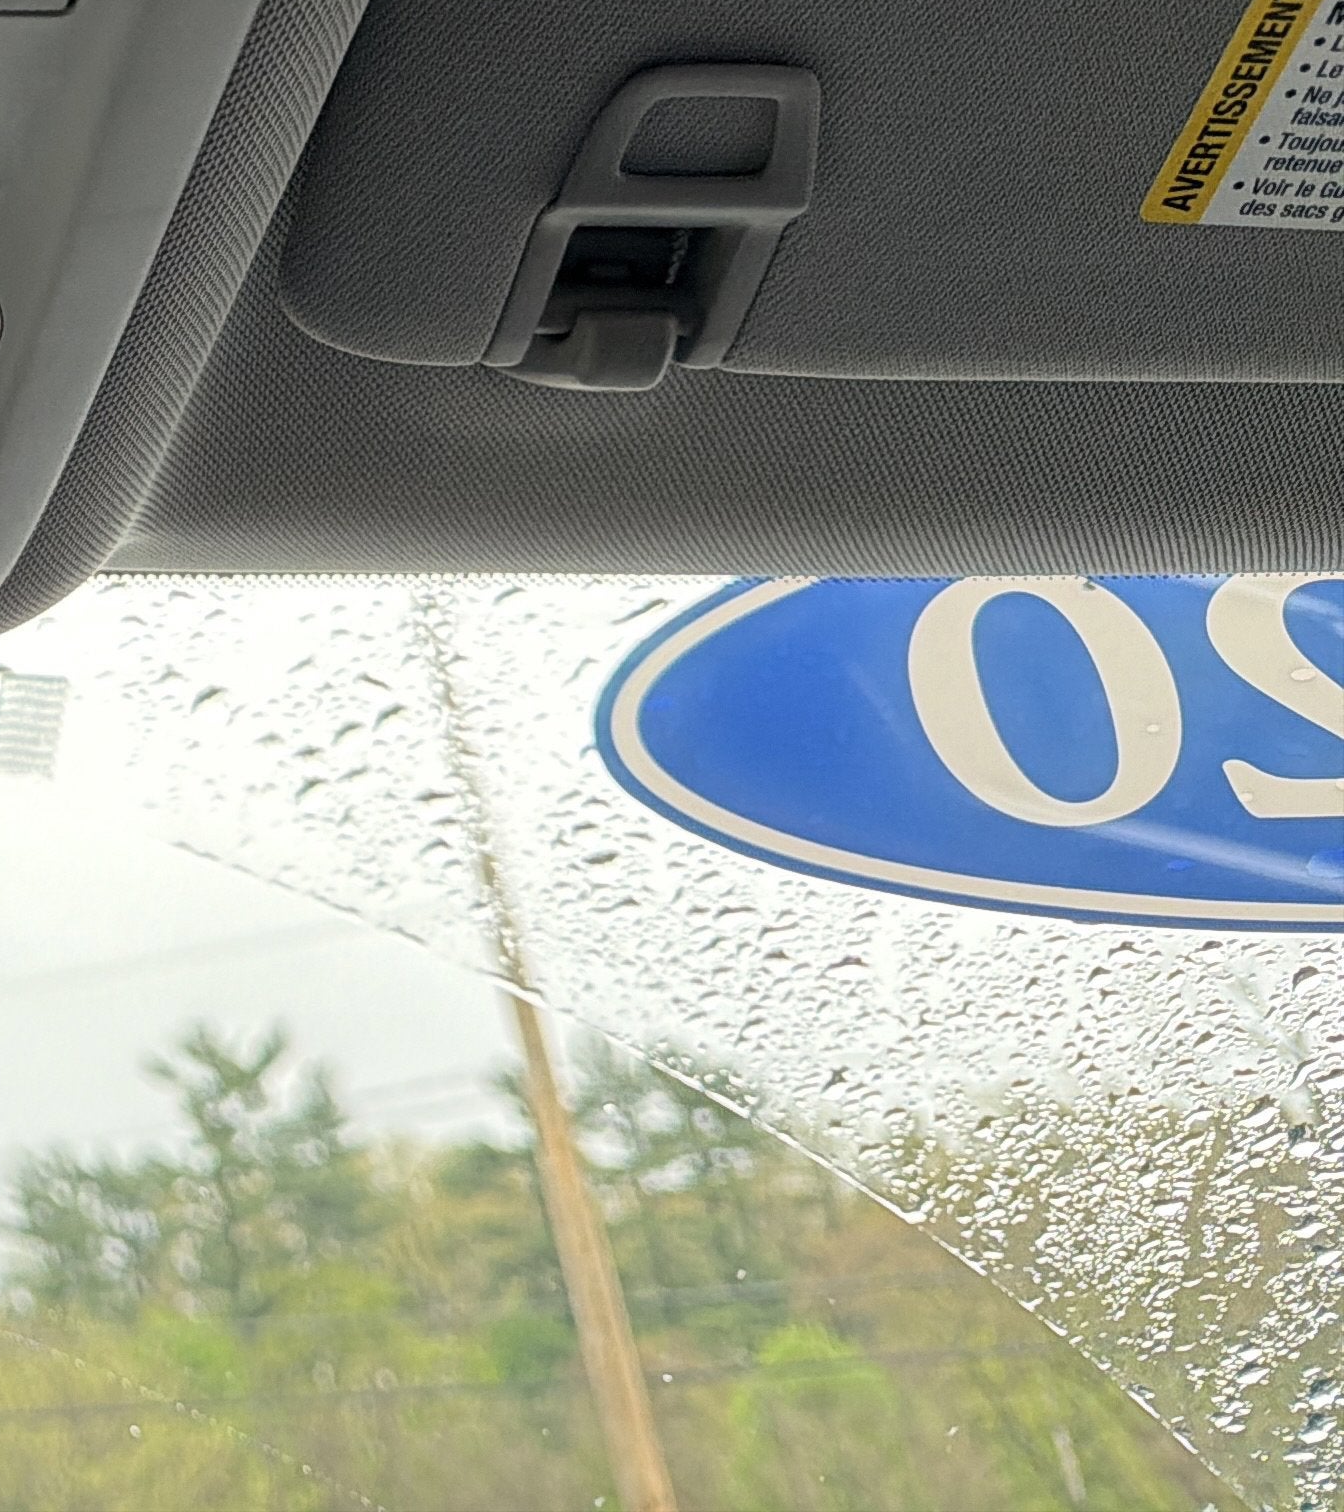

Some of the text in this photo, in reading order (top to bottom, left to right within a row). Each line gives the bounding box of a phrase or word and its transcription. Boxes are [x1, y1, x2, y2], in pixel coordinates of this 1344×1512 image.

[1301, 85, 1333, 106] Ne
[1263, 155, 1343, 174] retenue
[1252, 176, 1294, 197] Voir
[1294, 179, 1316, 198] le
[1239, 199, 1278, 217] des
[1279, 203, 1330, 220] sacs
